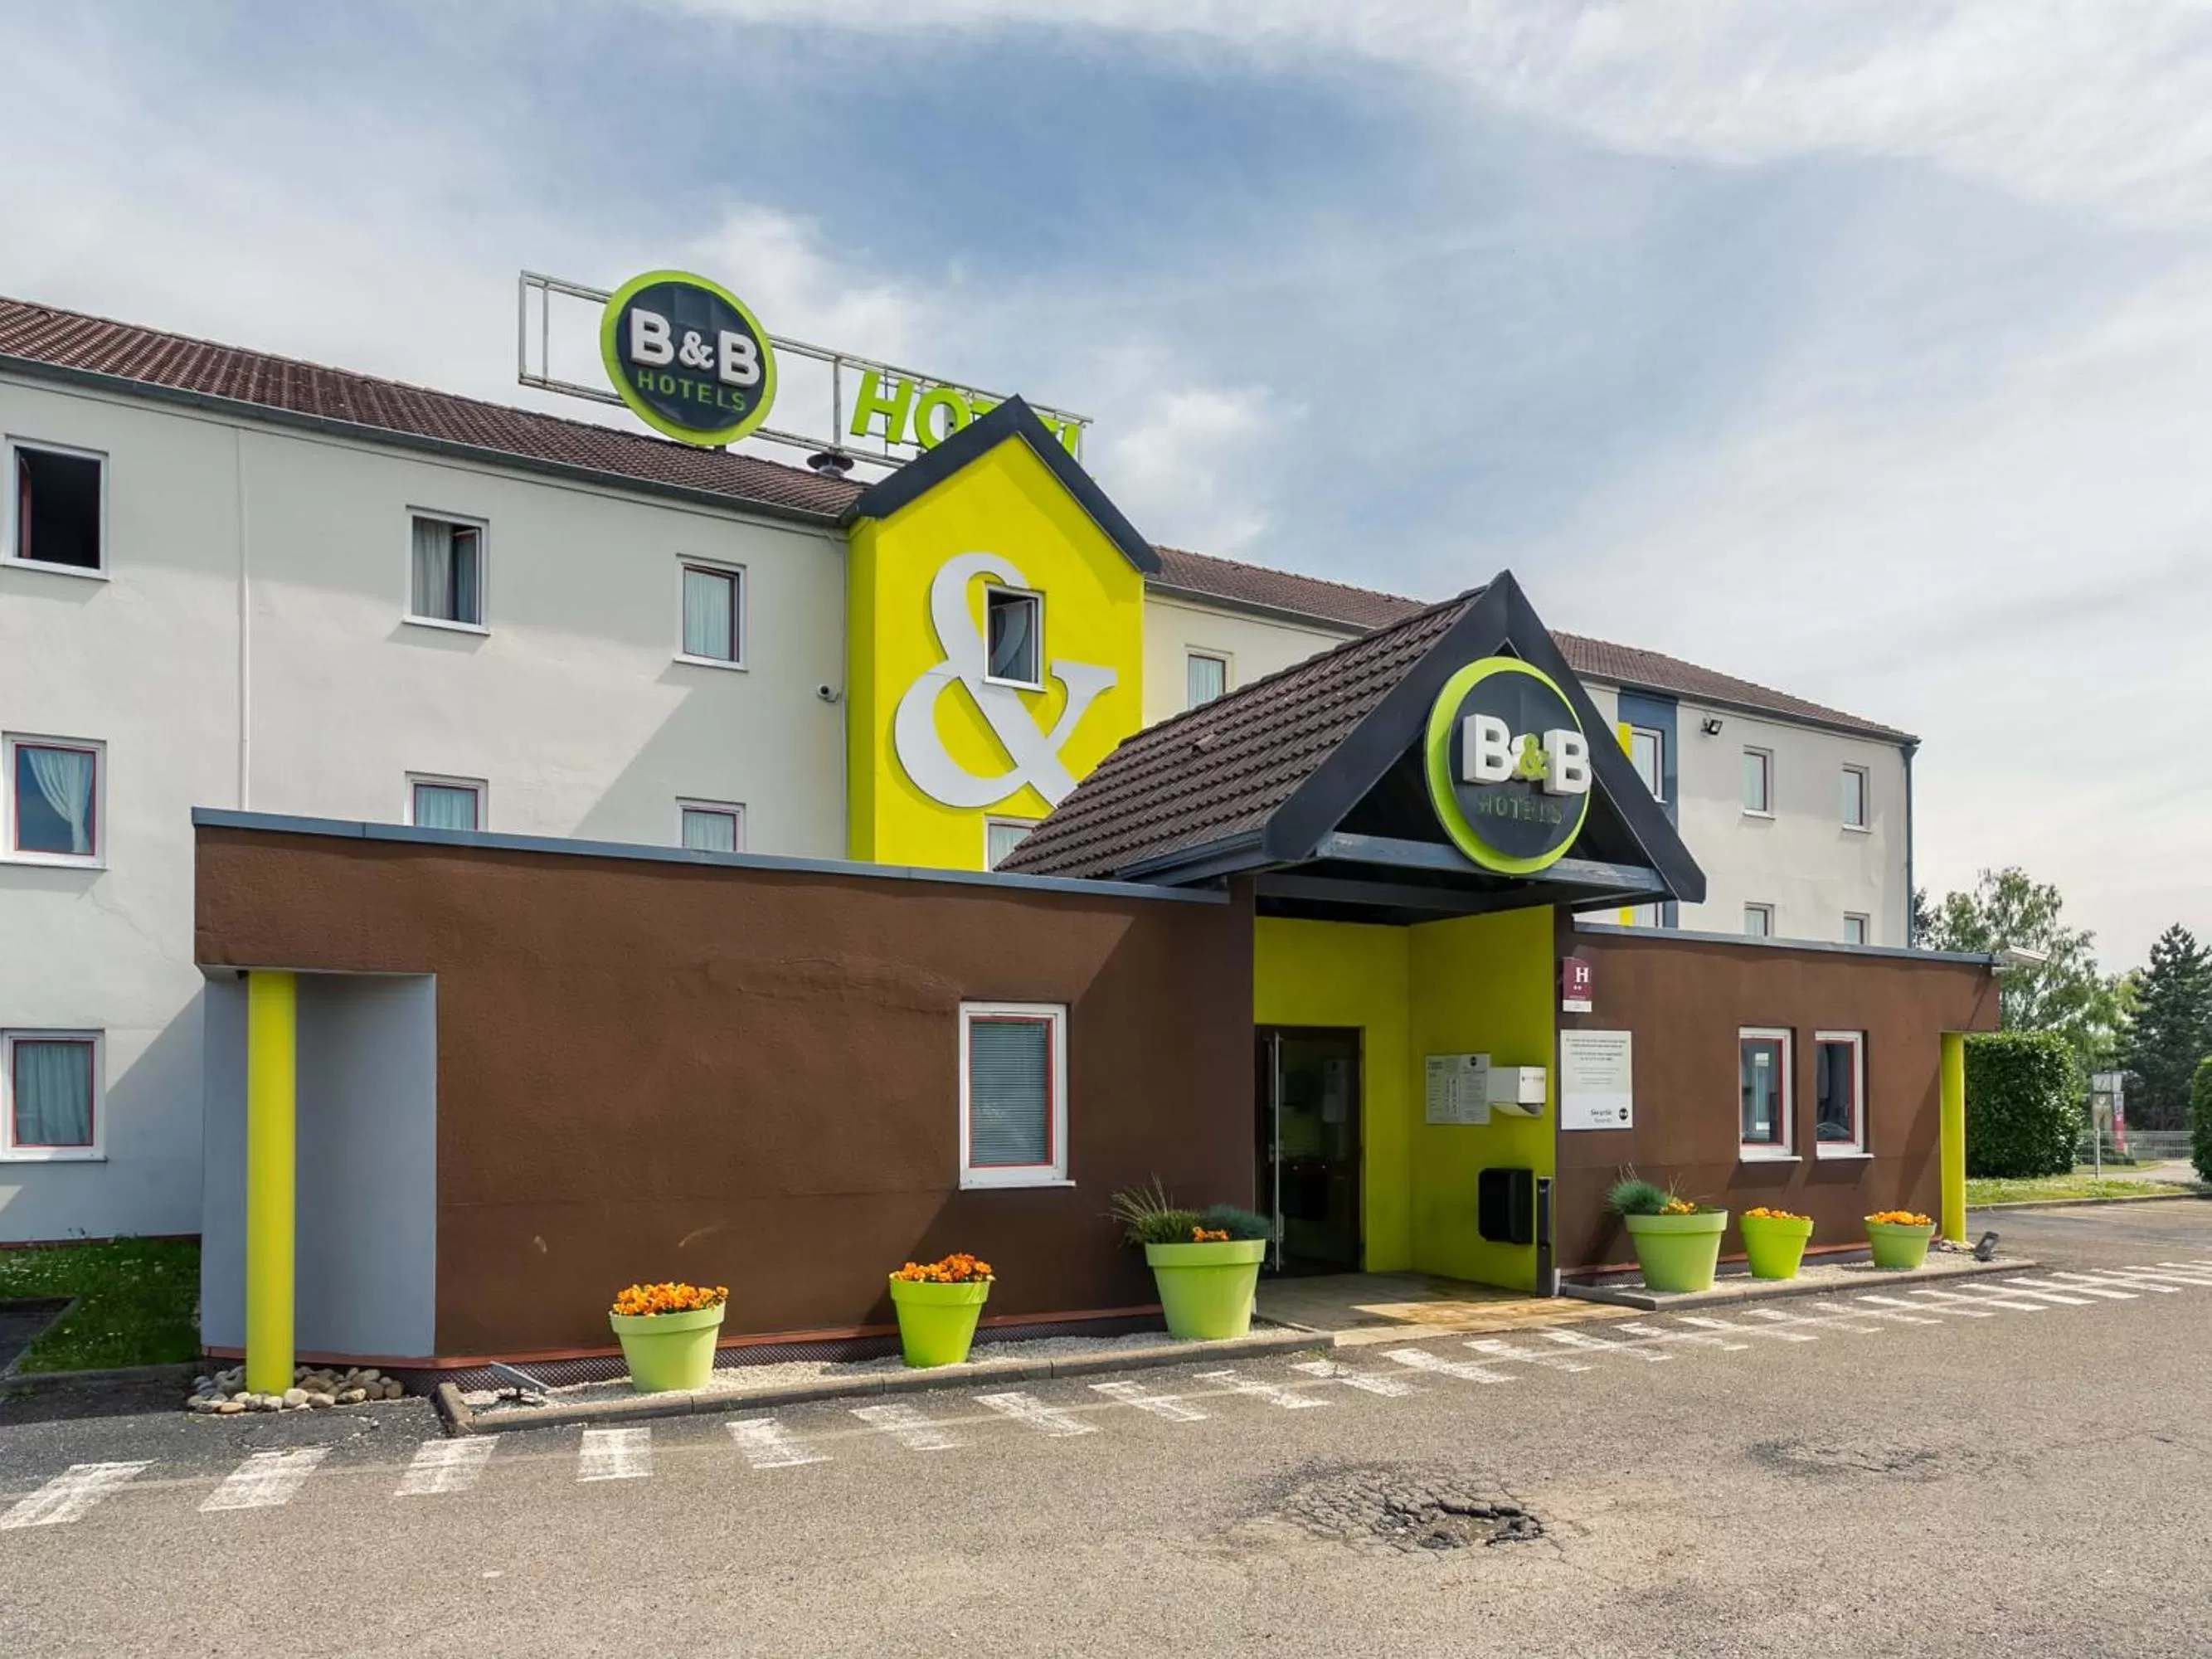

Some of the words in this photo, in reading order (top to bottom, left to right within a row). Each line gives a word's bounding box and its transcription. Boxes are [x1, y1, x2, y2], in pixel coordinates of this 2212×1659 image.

[630, 307, 761, 387] B&B
[637, 370, 746, 411] HOTELS
[1462, 713, 1592, 795] B&B
[1478, 794, 1563, 825] HOTELS
[1576, 966, 1589, 983] H
